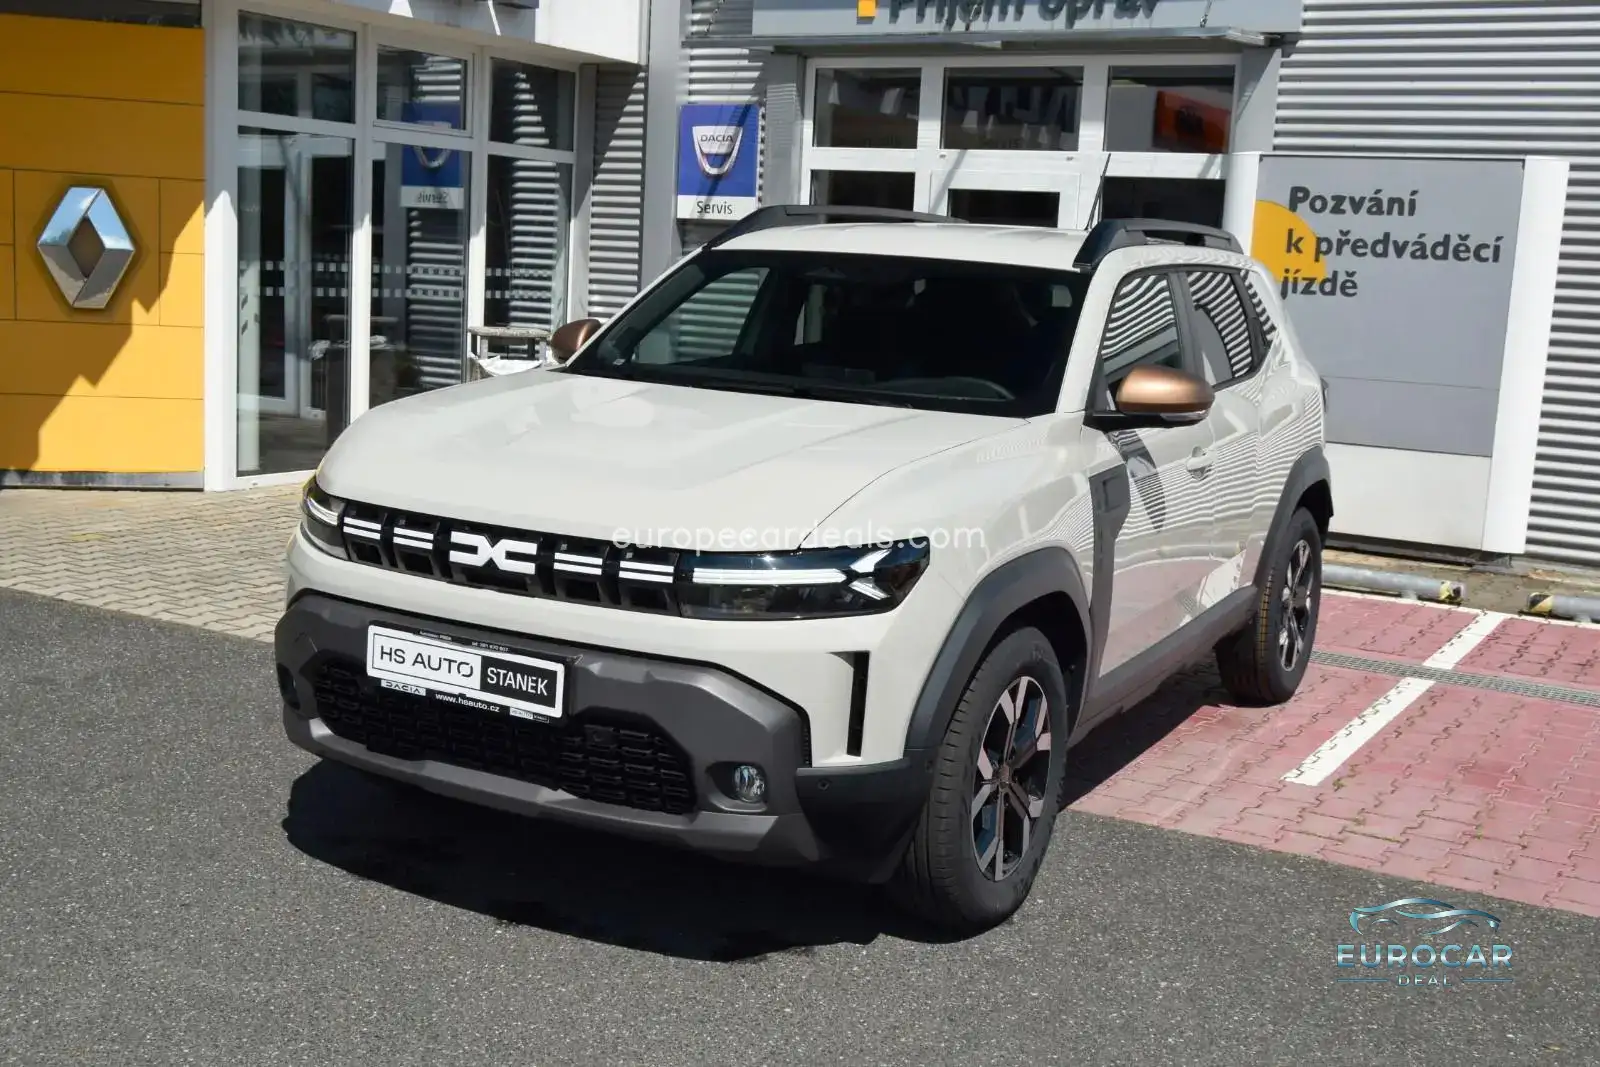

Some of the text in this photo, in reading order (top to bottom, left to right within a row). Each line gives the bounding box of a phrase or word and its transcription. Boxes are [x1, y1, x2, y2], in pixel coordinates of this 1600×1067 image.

[700, 134, 734, 143] DACIA
[696, 200, 733, 214] Servis
[1289, 186, 1419, 216] Pozvání
[1285, 228, 1504, 263] k předváděcí
[1280, 268, 1358, 300] jízdě
[380, 645, 548, 696] HS AUTO STANEK
[435, 693, 500, 712] www.hsauto.cz
